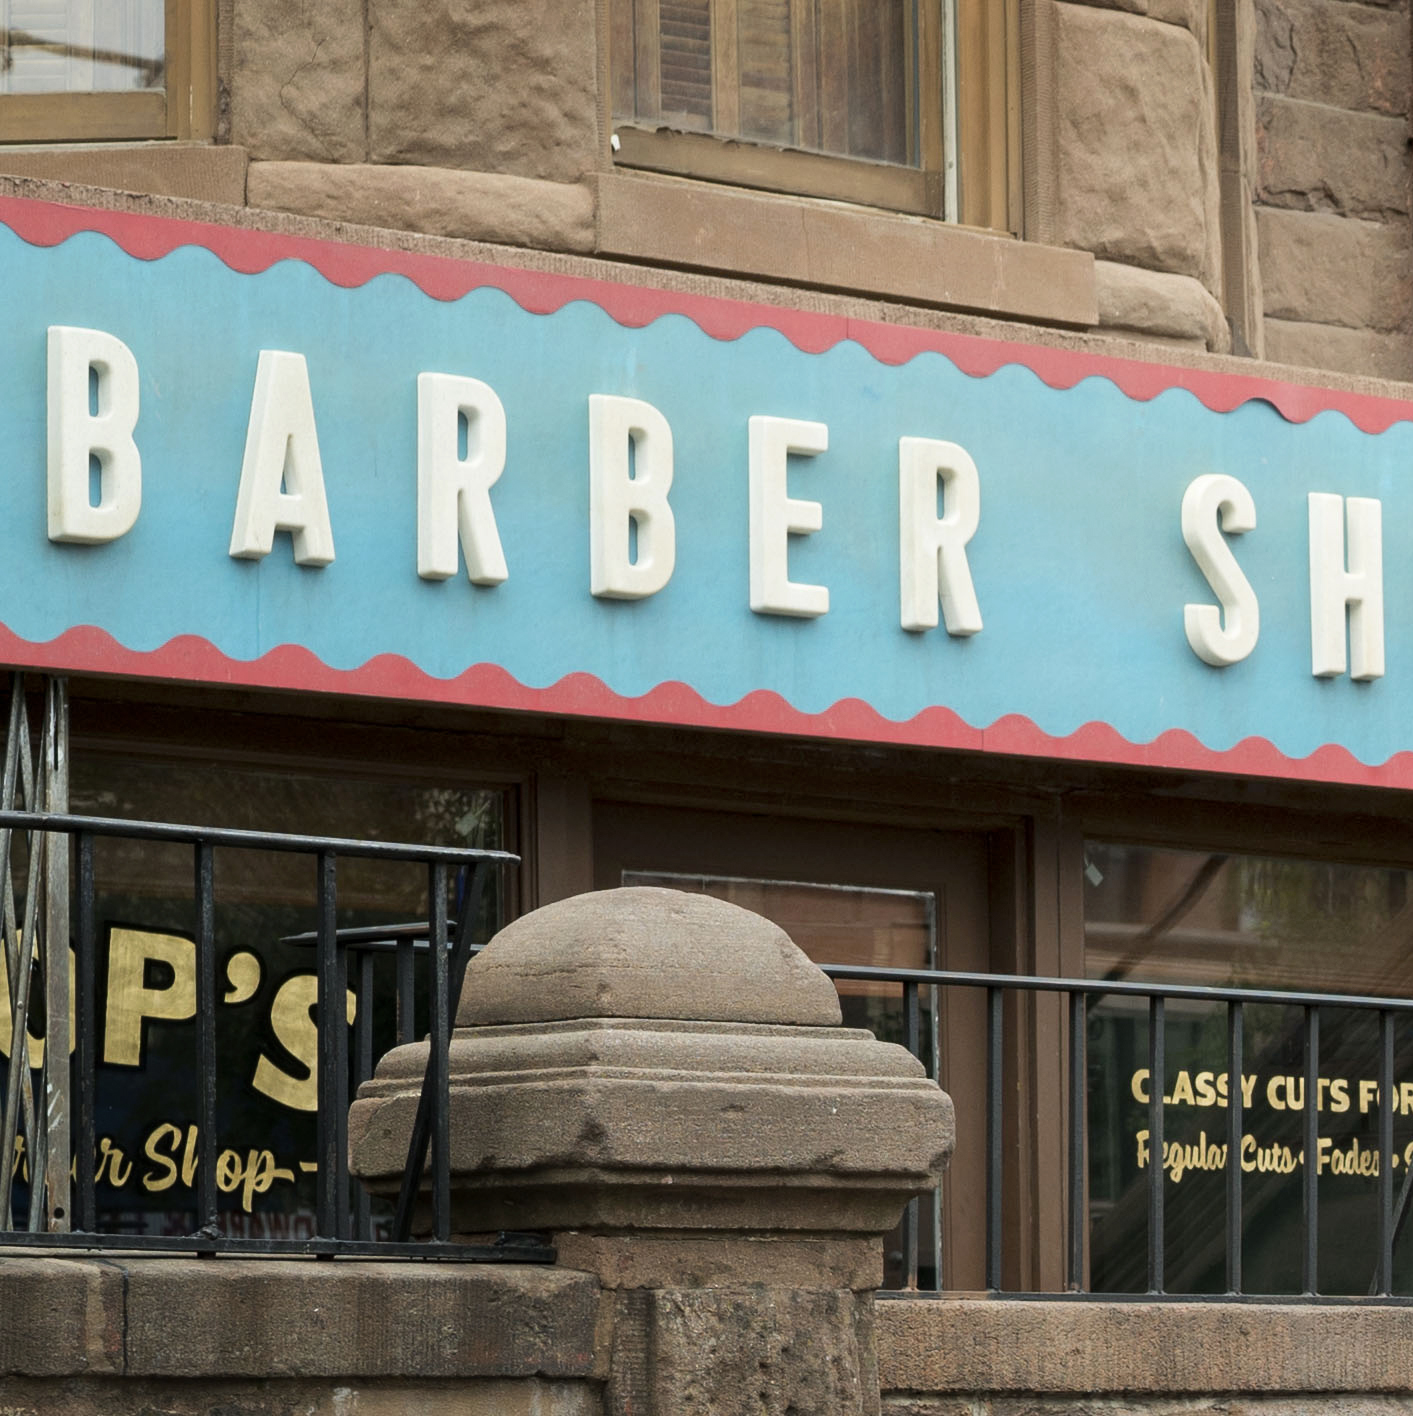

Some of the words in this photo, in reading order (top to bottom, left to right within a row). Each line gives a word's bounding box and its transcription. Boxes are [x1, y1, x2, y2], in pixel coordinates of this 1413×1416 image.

[46, 325, 983, 638] BARBER
[1131, 1068, 1258, 1109] CASSY
[1266, 1075, 1351, 1113] CUTS
[1240, 1134, 1297, 1174] Cuts
[1316, 1137, 1380, 1177] Fades
